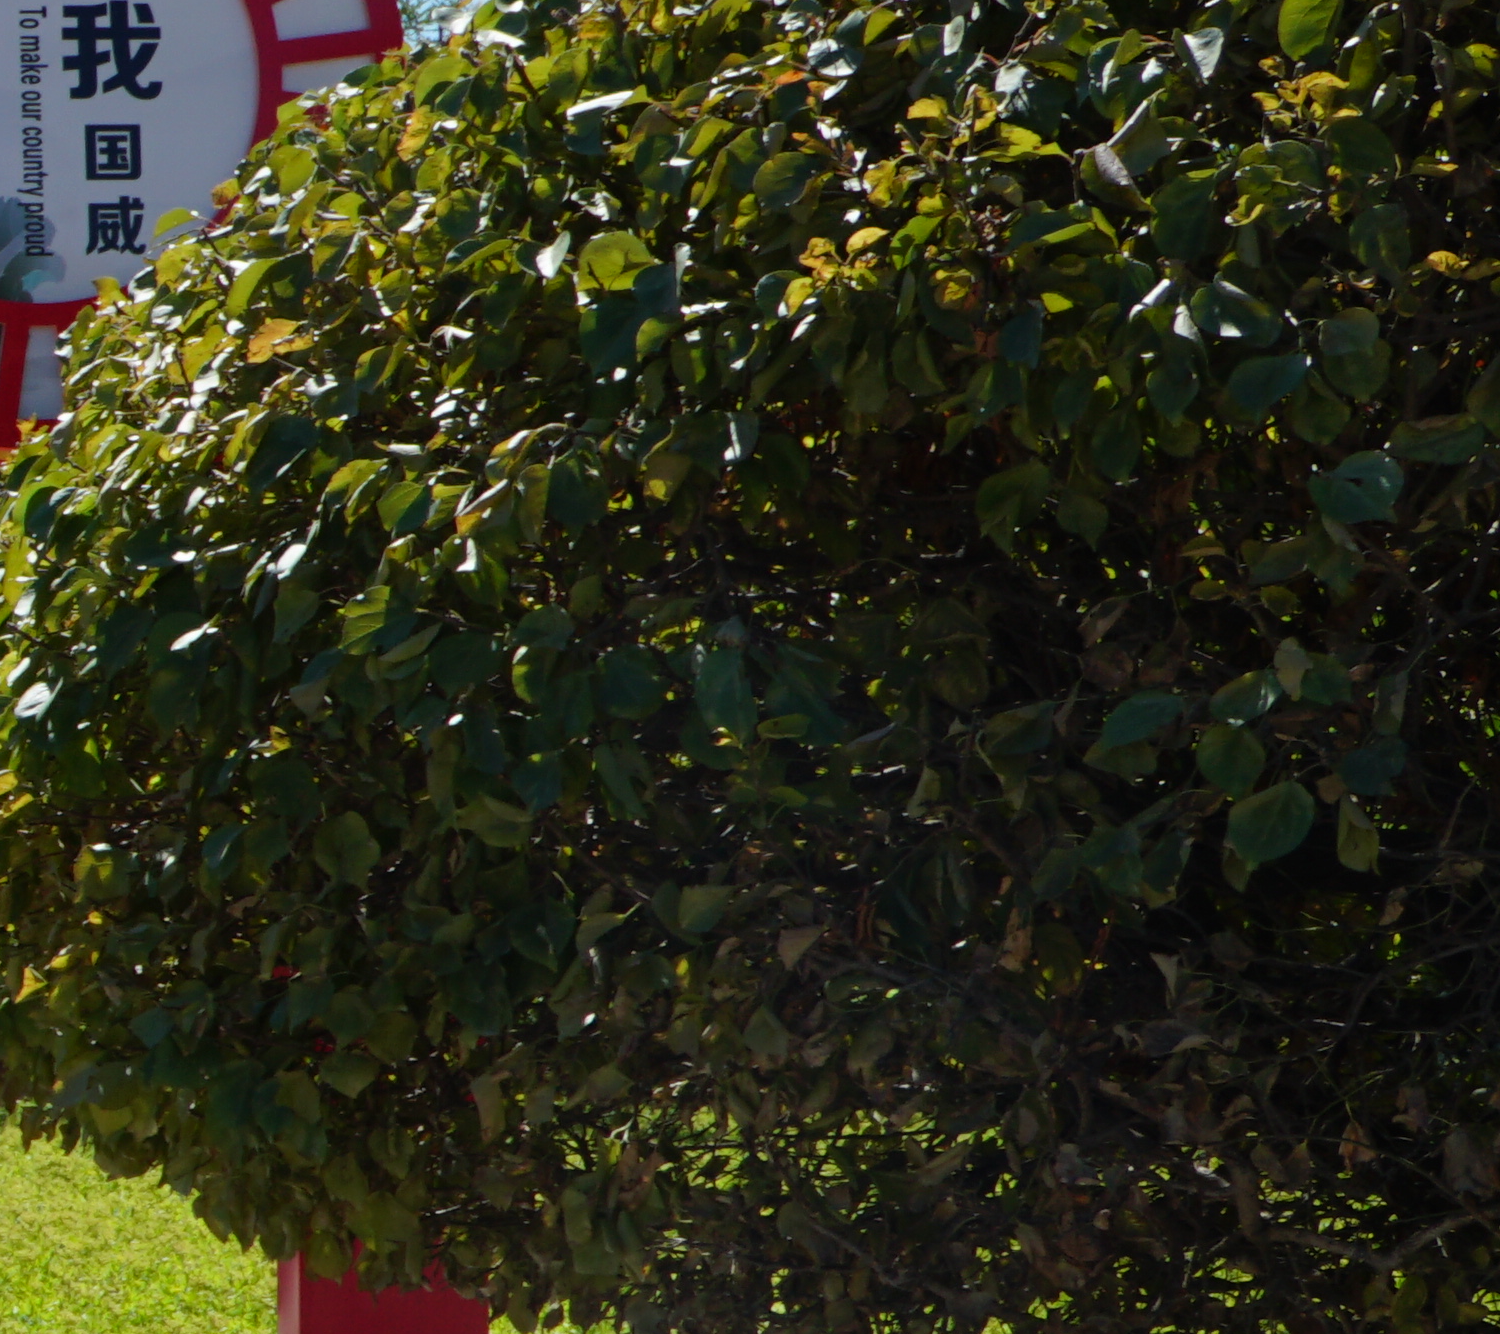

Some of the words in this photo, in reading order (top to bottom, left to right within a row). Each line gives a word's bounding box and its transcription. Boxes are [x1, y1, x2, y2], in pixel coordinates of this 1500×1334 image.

[19, 6, 47, 29] To
[19, 36, 49, 85] make
[21, 91, 42, 121] our
[17, 126, 49, 197] country
[17, 202, 54, 257] proud
